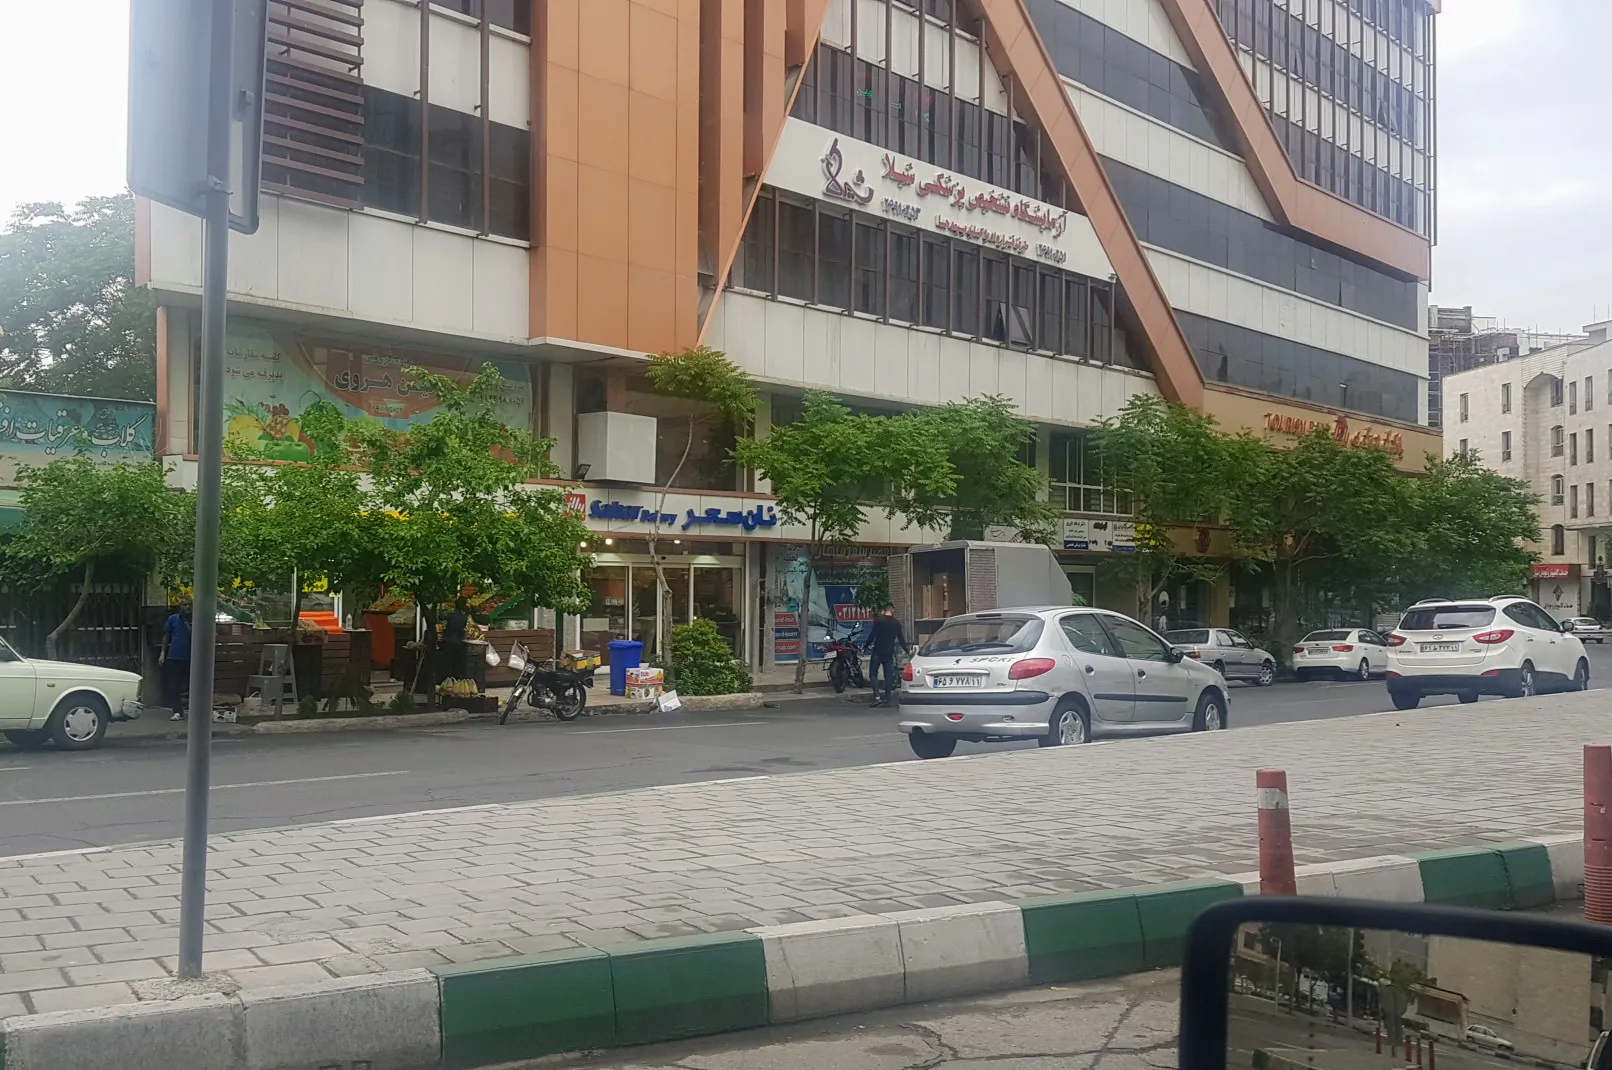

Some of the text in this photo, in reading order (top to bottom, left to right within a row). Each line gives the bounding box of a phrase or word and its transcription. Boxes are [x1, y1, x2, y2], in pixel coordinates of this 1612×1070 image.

[881, 152, 1069, 239] آزمایشگاه تشخیص پزشکی شیلا
[334, 369, 393, 393] هروی
[15, 409, 80, 456] عرقیات
[91, 413, 149, 458] گلاب
[681, 504, 777, 531] نان سحر
